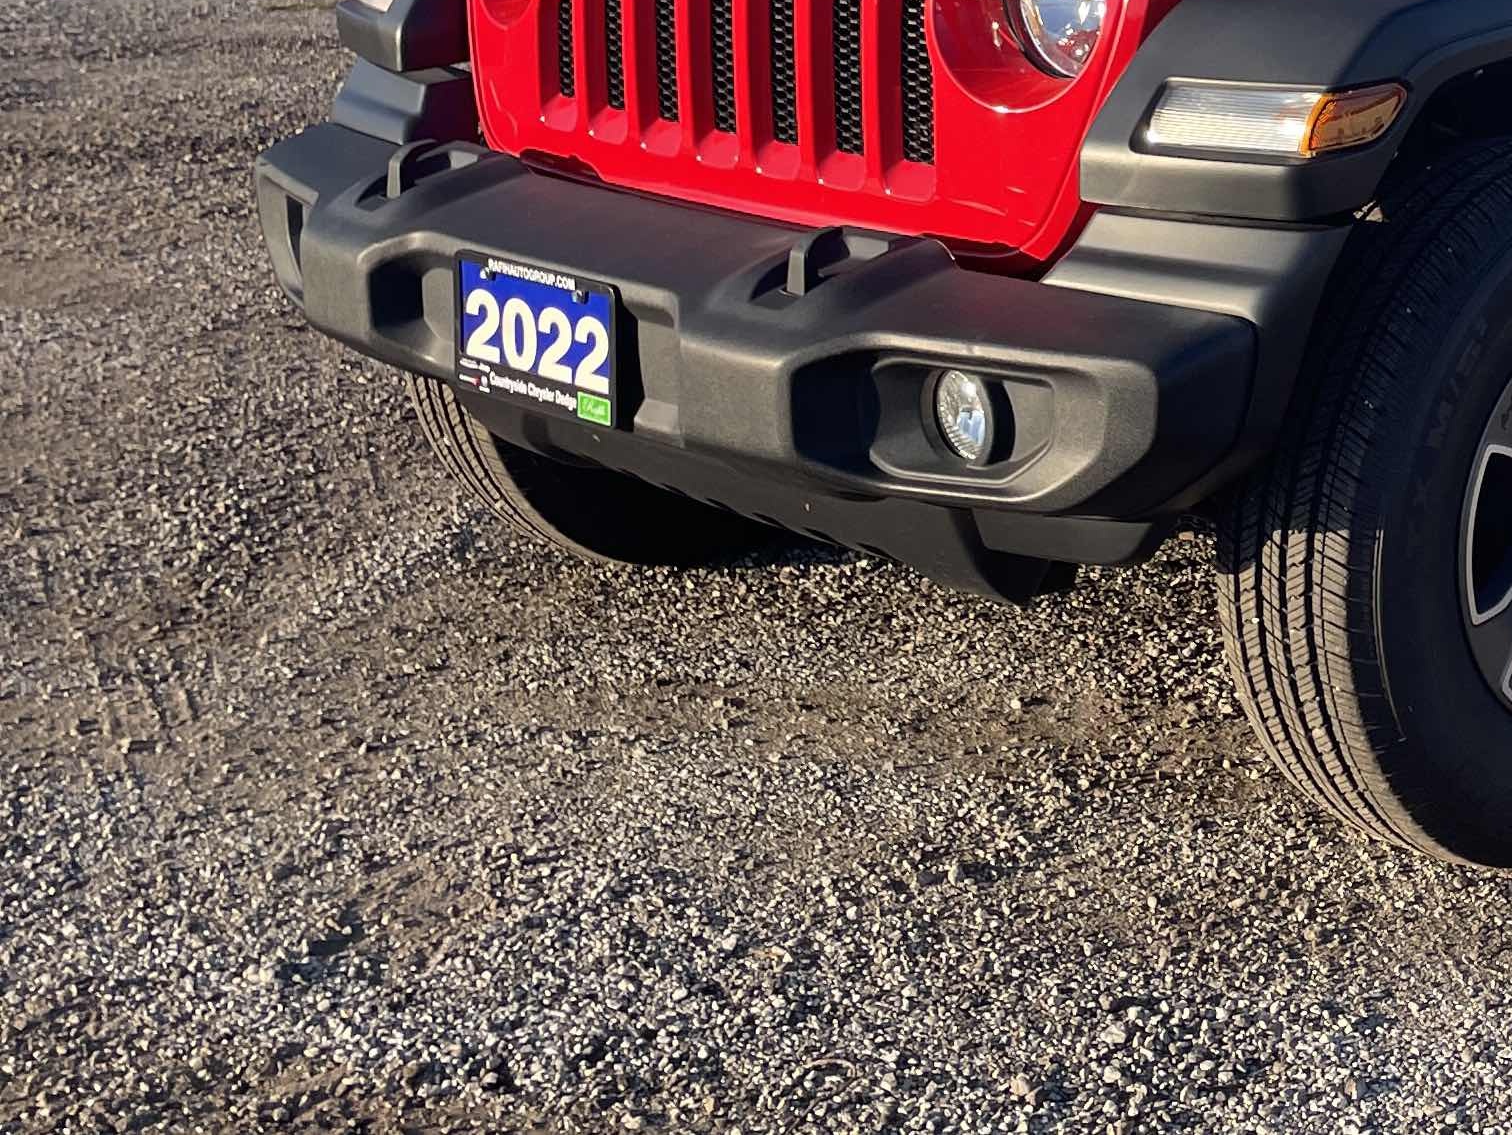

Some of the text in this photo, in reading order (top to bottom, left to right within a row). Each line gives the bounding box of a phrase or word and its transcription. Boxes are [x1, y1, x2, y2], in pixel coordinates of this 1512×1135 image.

[465, 289, 609, 395] 2022
[489, 370, 529, 396] Countryside
[527, 381, 556, 403] Chrysler
[554, 390, 578, 412] Dodge
